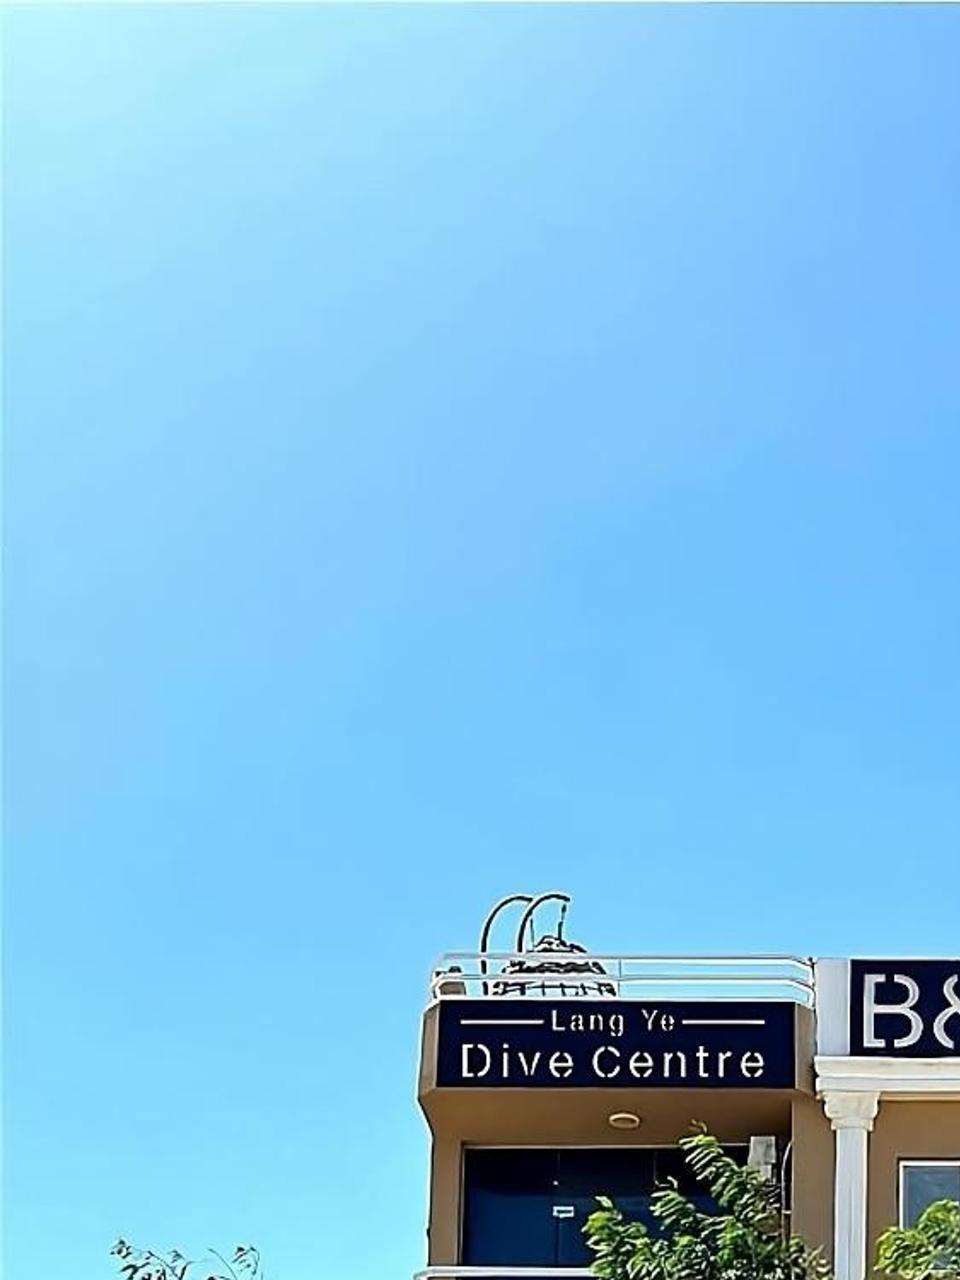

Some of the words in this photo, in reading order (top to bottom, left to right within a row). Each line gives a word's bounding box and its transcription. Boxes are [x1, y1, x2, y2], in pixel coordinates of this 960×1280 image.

[551, 1009, 624, 1037] Lang
[641, 1009, 675, 1032] Ye
[461, 1043, 574, 1078] Dive
[592, 1045, 765, 1079] Centre
